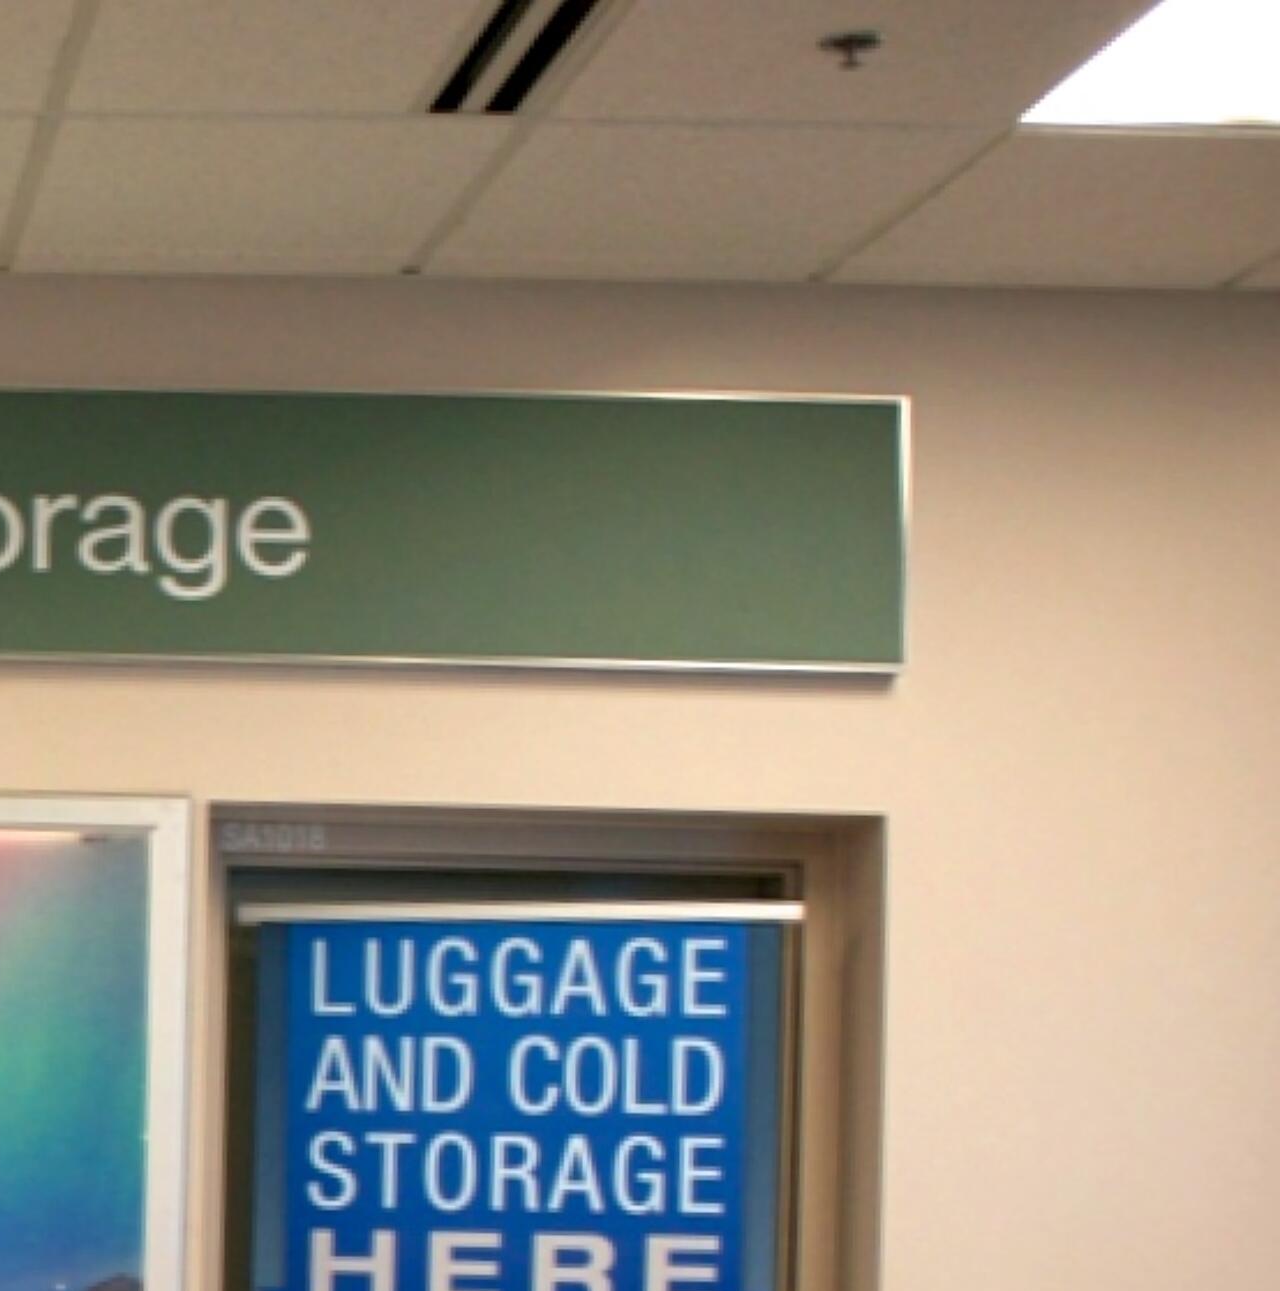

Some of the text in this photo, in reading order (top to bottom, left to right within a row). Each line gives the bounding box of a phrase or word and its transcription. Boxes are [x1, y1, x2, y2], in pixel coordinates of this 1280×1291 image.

[312, 935, 729, 1019] LUGGAGE
[305, 1033, 726, 1117] AND COLD
[306, 1129, 726, 1217] STORAGE
